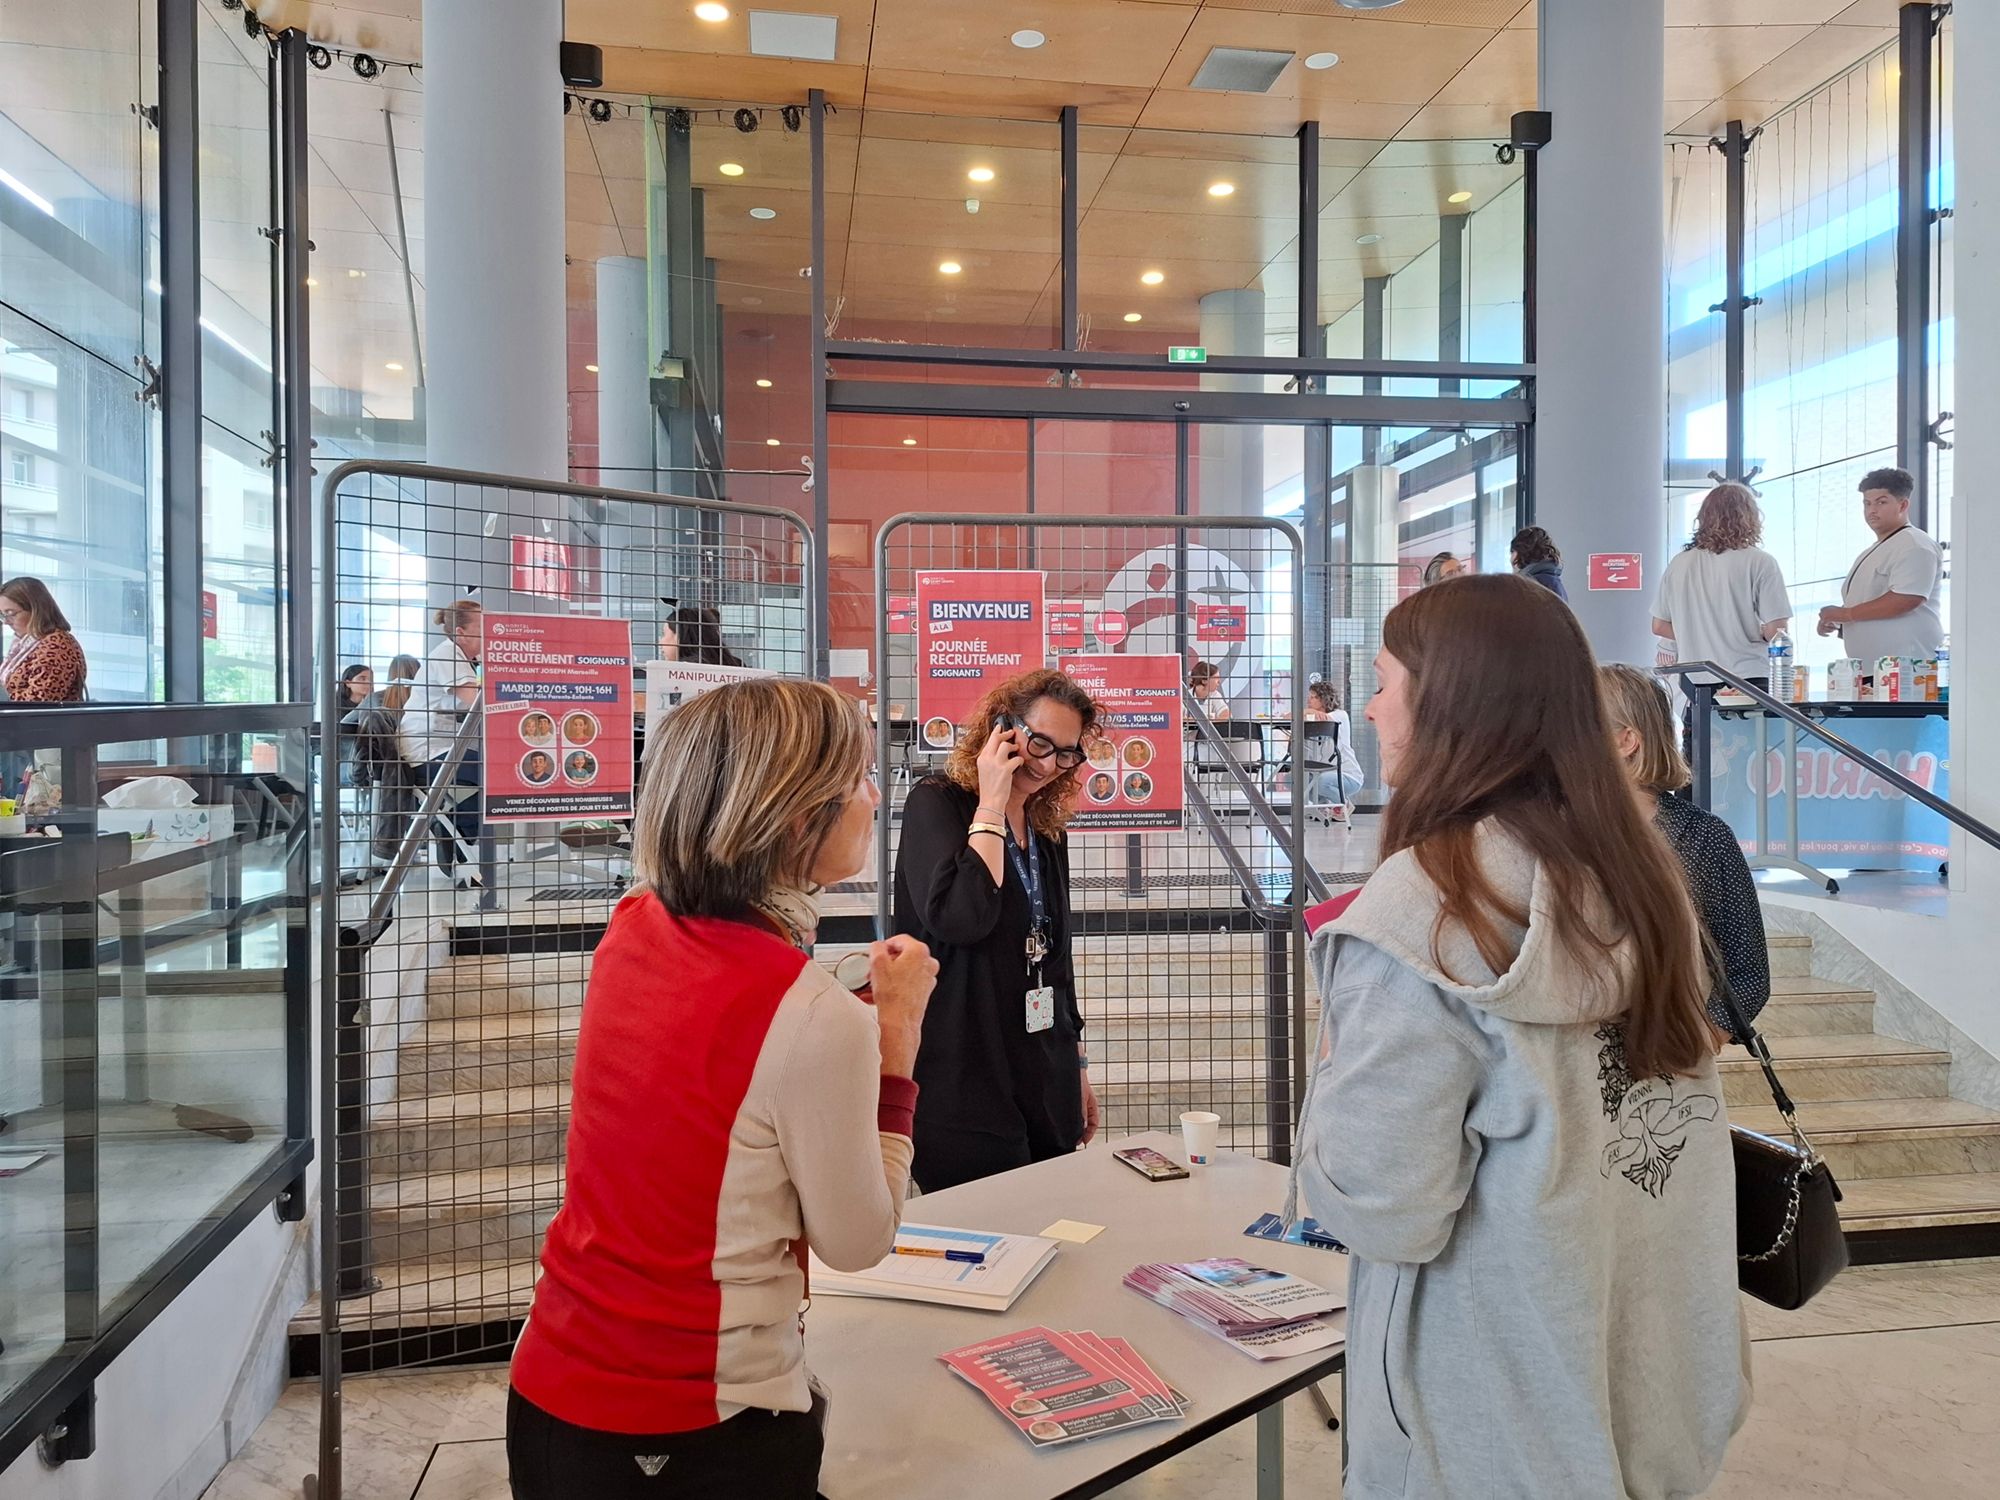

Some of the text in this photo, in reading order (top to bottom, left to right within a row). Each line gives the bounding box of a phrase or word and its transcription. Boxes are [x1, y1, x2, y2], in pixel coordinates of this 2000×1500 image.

[932, 603, 1029, 619] BIENVENUE
[940, 623, 949, 631] LA
[487, 639, 543, 652] JOURNÉE
[929, 637, 988, 652] JOURNÉE
[487, 652, 626, 666] RECRUTEMENT SOIGNANTS
[929, 654, 1022, 666] RECRUTEMENT
[488, 665, 517, 674] HÔPITAL
[540, 667, 566, 675] JOSEPH
[932, 669, 981, 677] SOIGNANTS
[1072, 676, 1106, 687] URNÉE
[501, 684, 534, 693] MARDI
[536, 684, 568, 695] 20/05
[574, 685, 613, 695] 10H-16H
[1084, 688, 1176, 698] UTEMENT SOIGNANTS
[1133, 714, 1165, 723] 10H-16H
